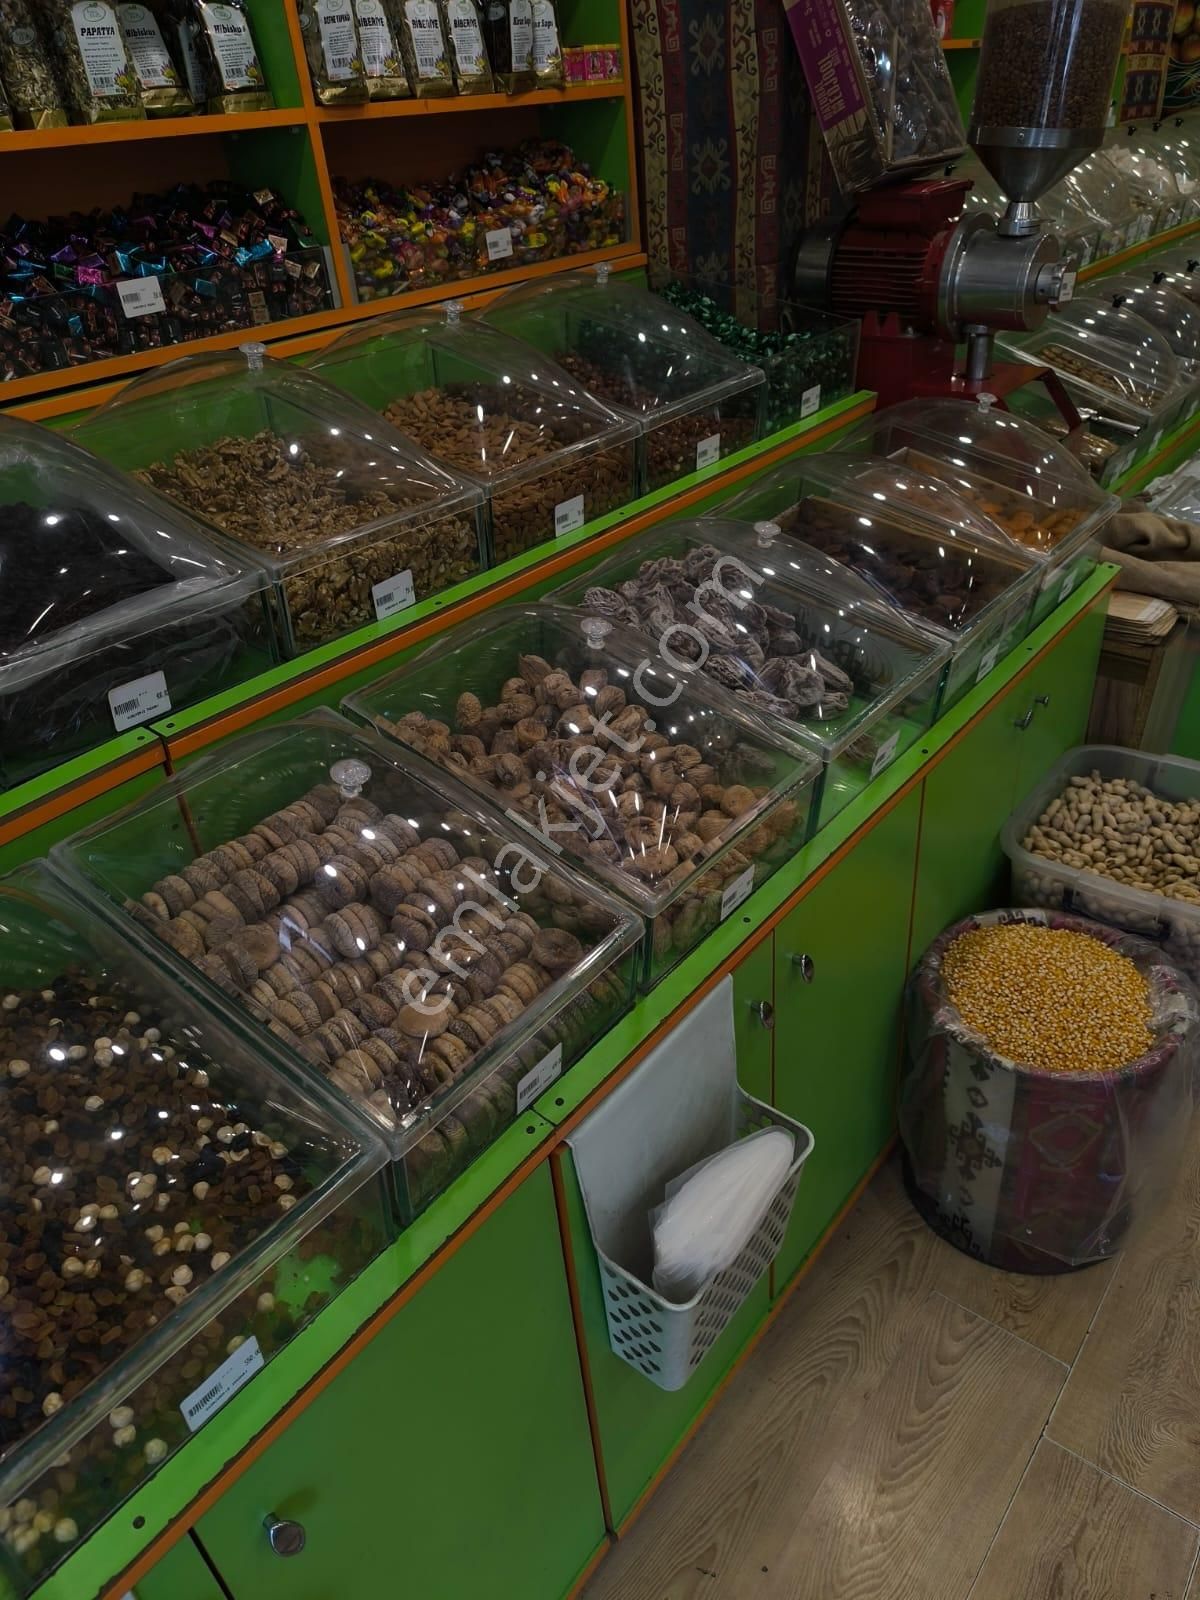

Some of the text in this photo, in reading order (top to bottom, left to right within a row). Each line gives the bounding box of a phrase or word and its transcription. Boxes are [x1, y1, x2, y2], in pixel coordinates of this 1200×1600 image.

[81, 27, 115, 36] PAPATYA
[125, 28, 156, 37] Hibiskus
[817, 51, 846, 114] MEDJOOL
